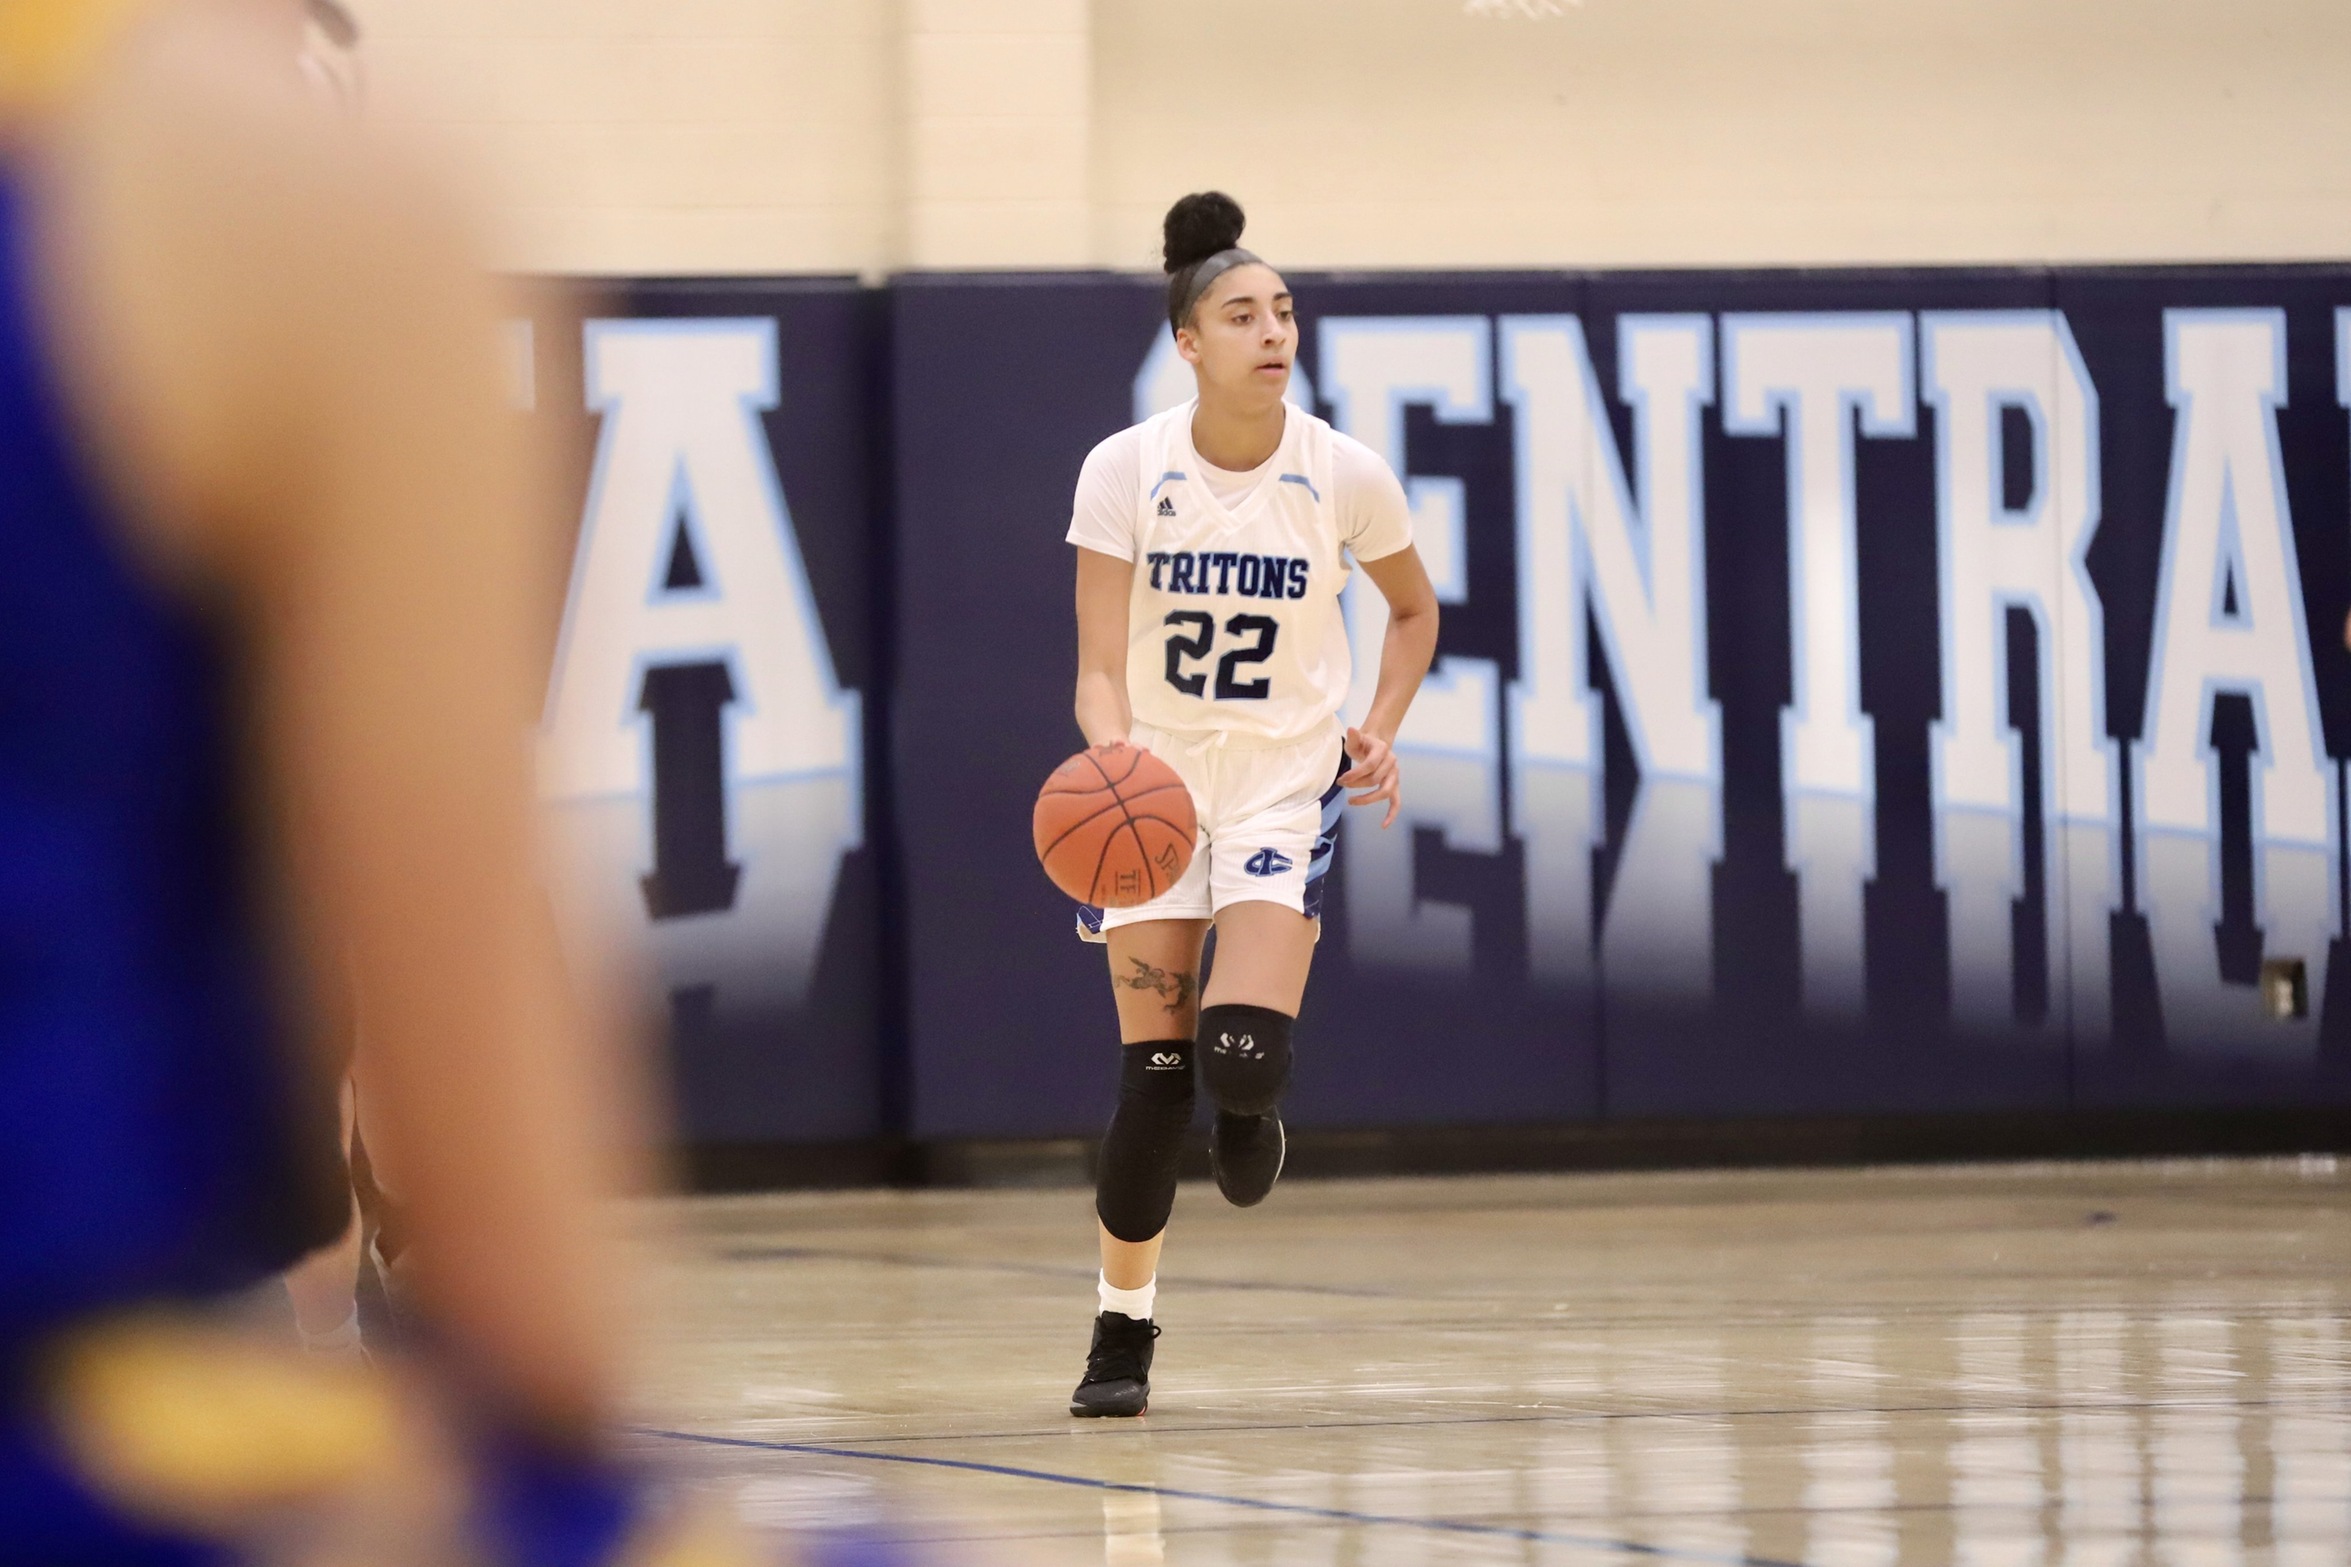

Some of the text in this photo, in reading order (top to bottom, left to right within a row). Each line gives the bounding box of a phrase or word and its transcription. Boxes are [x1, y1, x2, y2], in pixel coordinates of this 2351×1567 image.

[512, 316, 864, 802] A
[1133, 306, 2351, 852] ENTRA
[1146, 551, 1309, 600] TRITONS
[1163, 608, 1280, 701] 22
